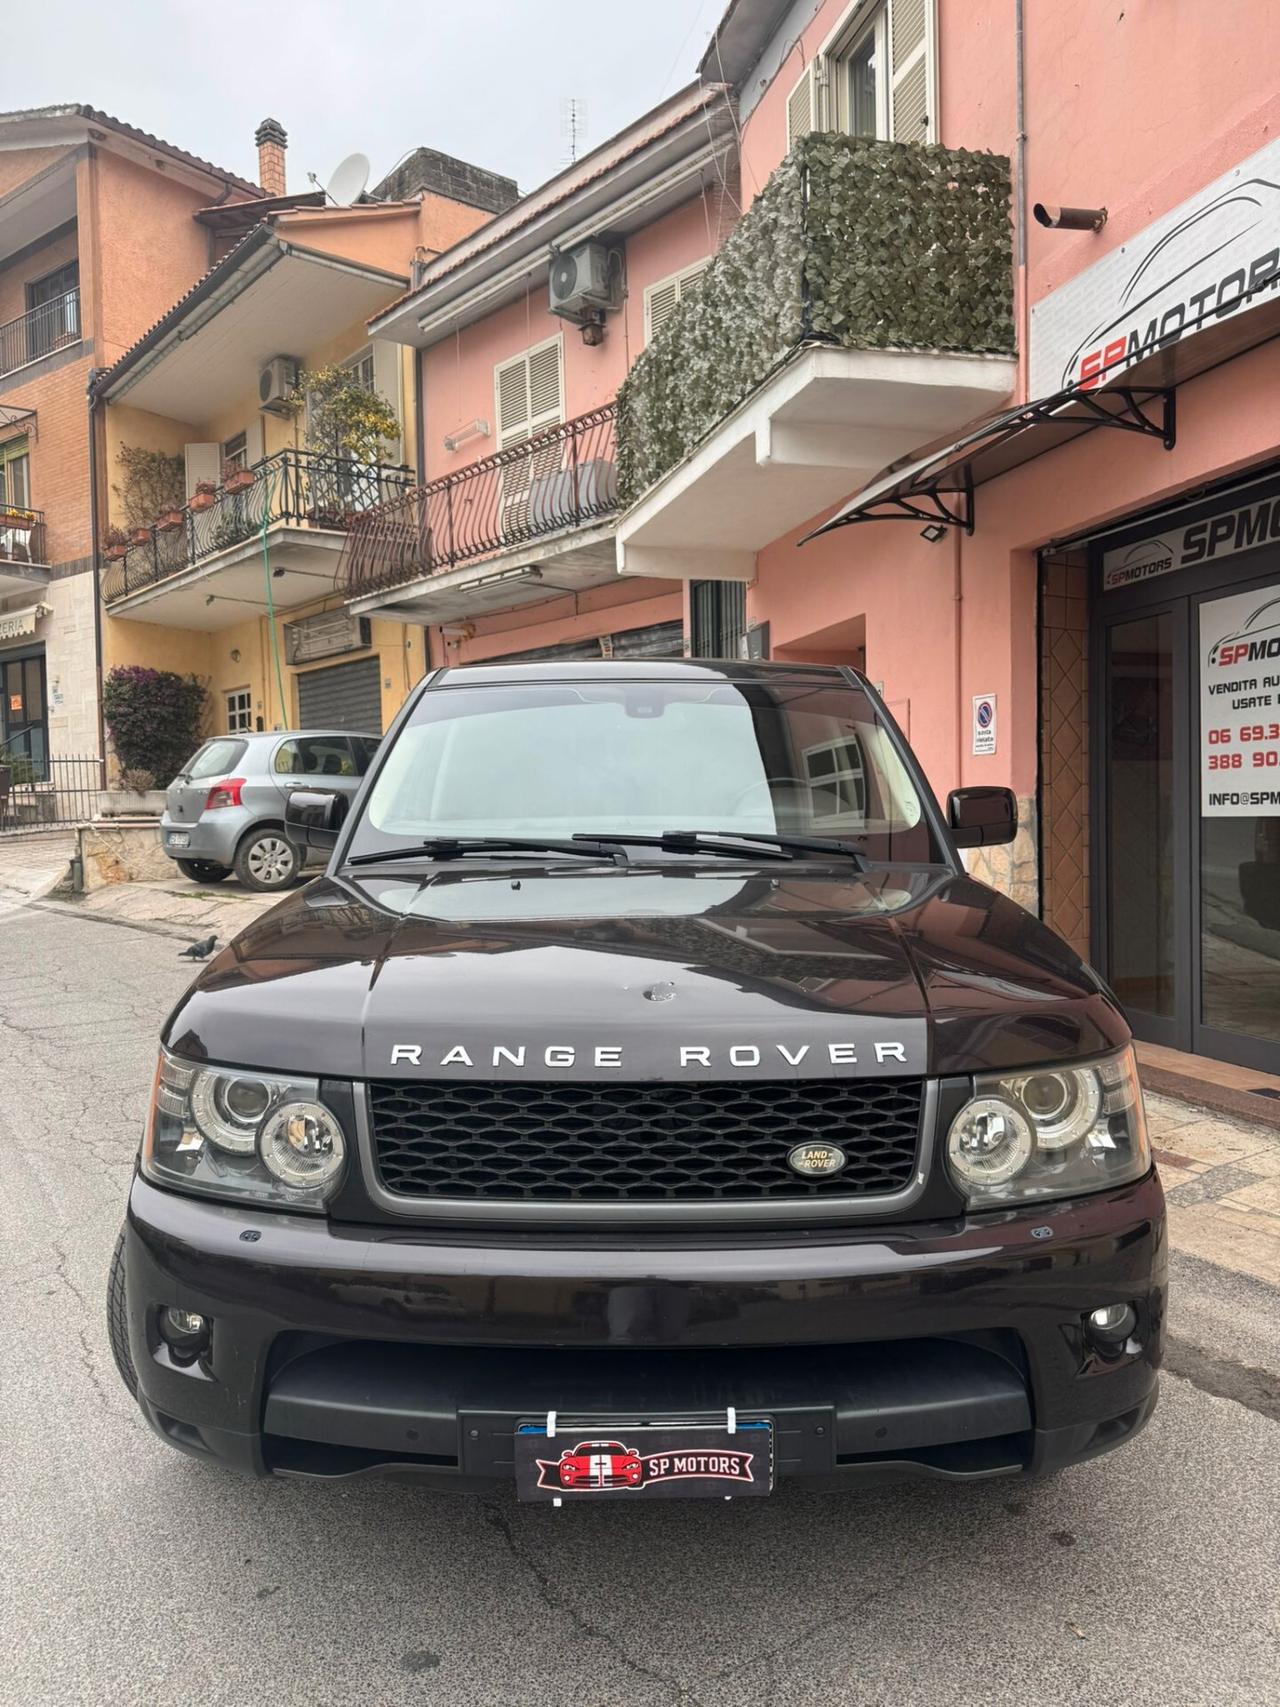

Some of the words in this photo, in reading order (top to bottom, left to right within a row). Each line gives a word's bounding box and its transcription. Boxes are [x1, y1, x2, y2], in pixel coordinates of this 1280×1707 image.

[1111, 557, 1172, 585] SPMOTORS
[0, 618, 24, 635] ERIA
[1208, 678, 1257, 695] VENDITA
[1232, 695, 1272, 710] USATE
[1208, 728, 1231, 745] 06
[1240, 723, 1280, 742] 69.3
[1208, 753, 1242, 770] 388
[390, 1044, 623, 1067] RANGE
[679, 1042, 908, 1067] ROVER
[649, 1458, 670, 1477] SP
[673, 1456, 741, 1475] MOTORS
